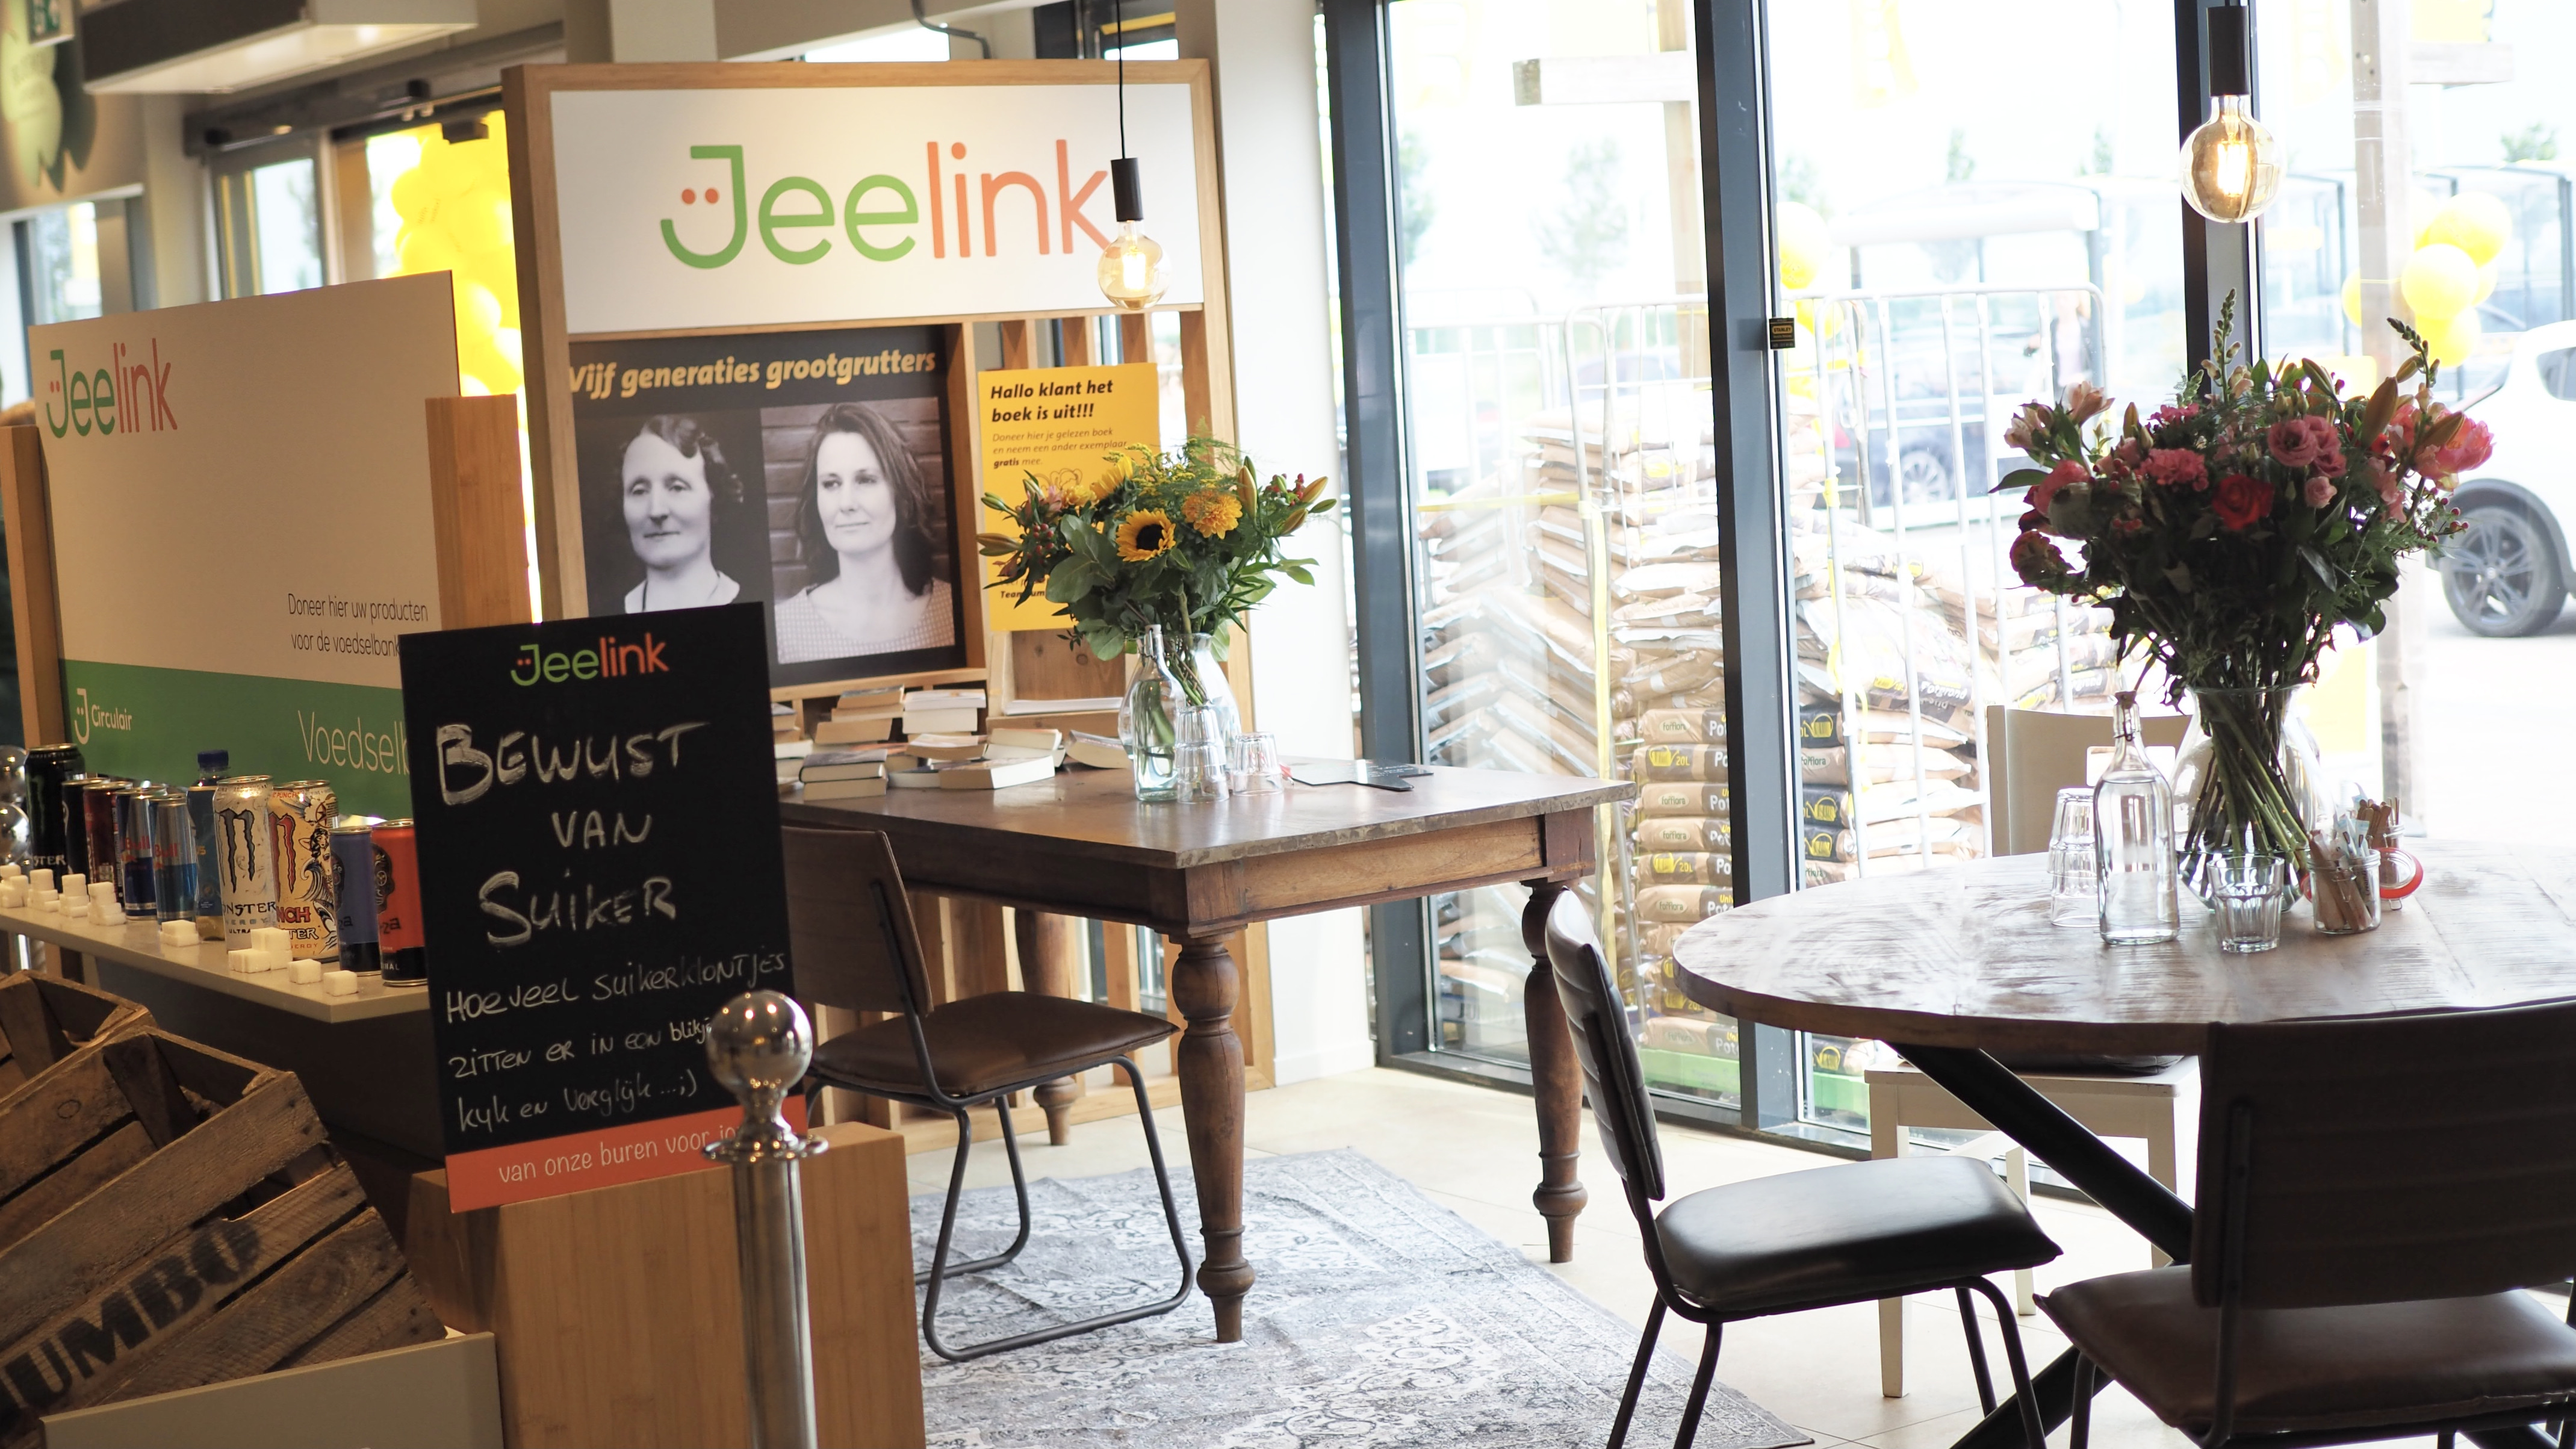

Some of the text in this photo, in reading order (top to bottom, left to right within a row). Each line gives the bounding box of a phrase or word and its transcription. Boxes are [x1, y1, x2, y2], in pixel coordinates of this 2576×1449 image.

[660, 139, 1120, 268] Jeelink
[570, 350, 936, 399] Vijf generaties grootgrutters
[46, 337, 178, 438] Jeelink
[990, 379, 1113, 399] Hallo klant het
[992, 403, 1094, 423] boek is uit!!!
[992, 427, 1113, 442] Doneer hier je gelezen boek
[1007, 445, 1031, 454] neem
[1033, 444, 1049, 453] een
[1052, 441, 1078, 452] ander
[1079, 439, 1128, 451] exemplaar
[993, 457, 1043, 469] gratis mee.
[288, 592, 429, 625] Doneer hier uw producten
[291, 633, 314, 650] voor
[317, 630, 331, 652] de
[510, 633, 669, 686] Jeelink
[92, 704, 132, 731] Circulair
[1676, 756, 1690, 766] 20L
[551, 810, 652, 849] VAN
[154, 843, 178, 857] Bull
[1679, 862, 1693, 872] 20L
[498, 1163, 537, 1183] van
[544, 1152, 593, 1176] onze
[600, 1141, 659, 1168] buren
[665, 1131, 710, 1153] voor
